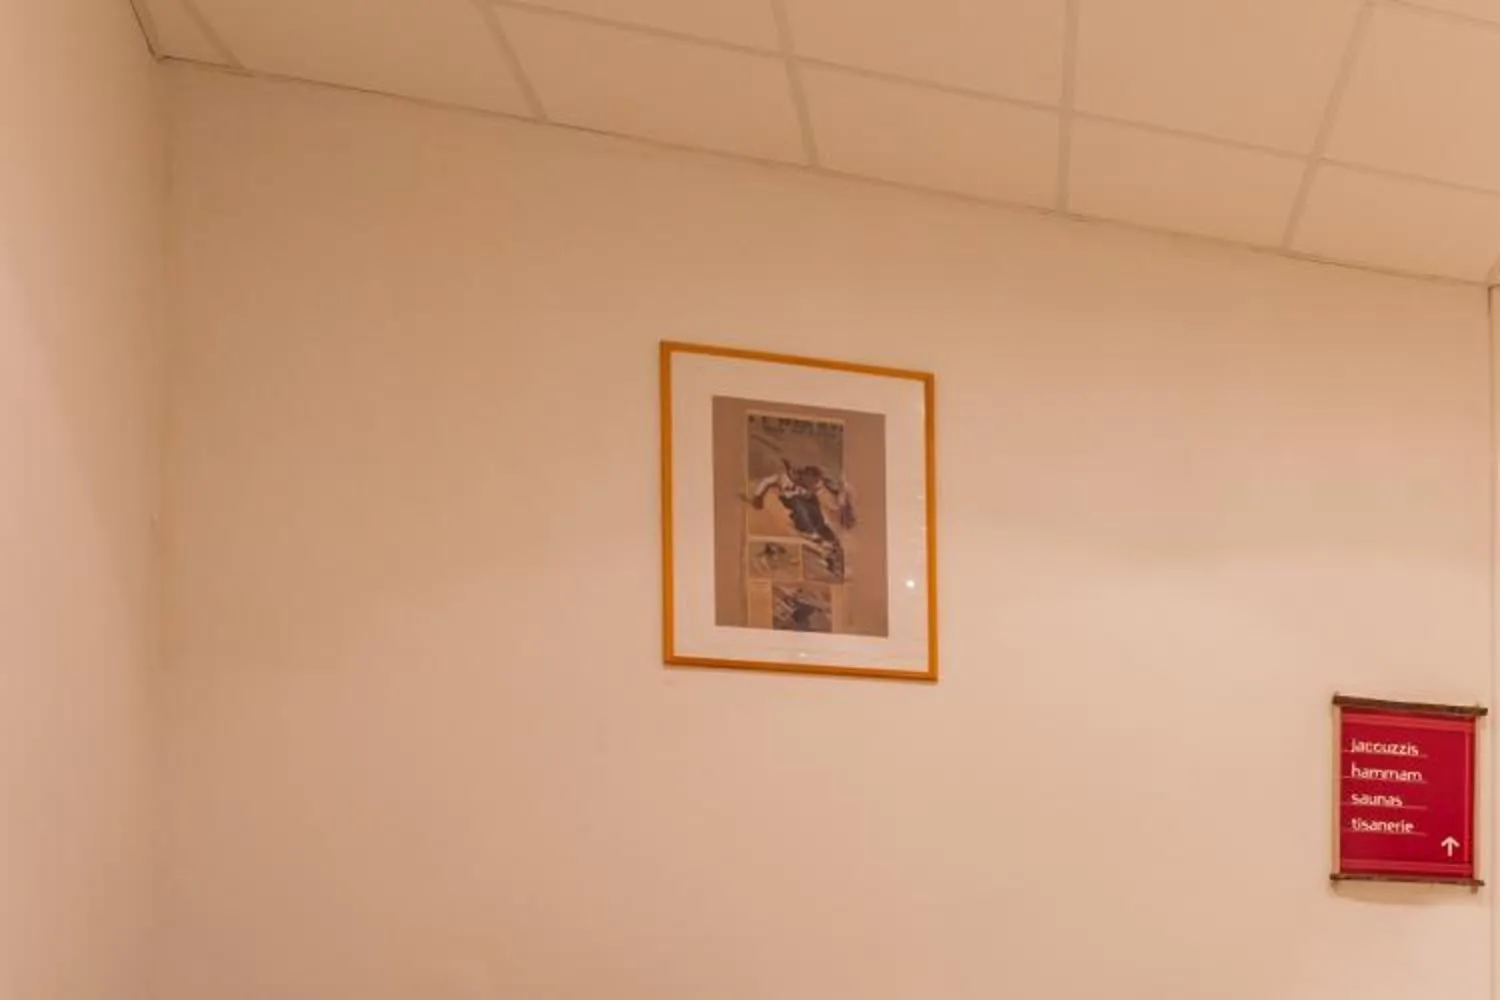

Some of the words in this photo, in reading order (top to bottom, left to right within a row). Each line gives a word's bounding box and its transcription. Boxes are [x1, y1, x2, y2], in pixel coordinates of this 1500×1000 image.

[1351, 761, 1423, 781] hammam
[1351, 793, 1403, 807] saunas
[1351, 817, 1414, 833] tisanerie
